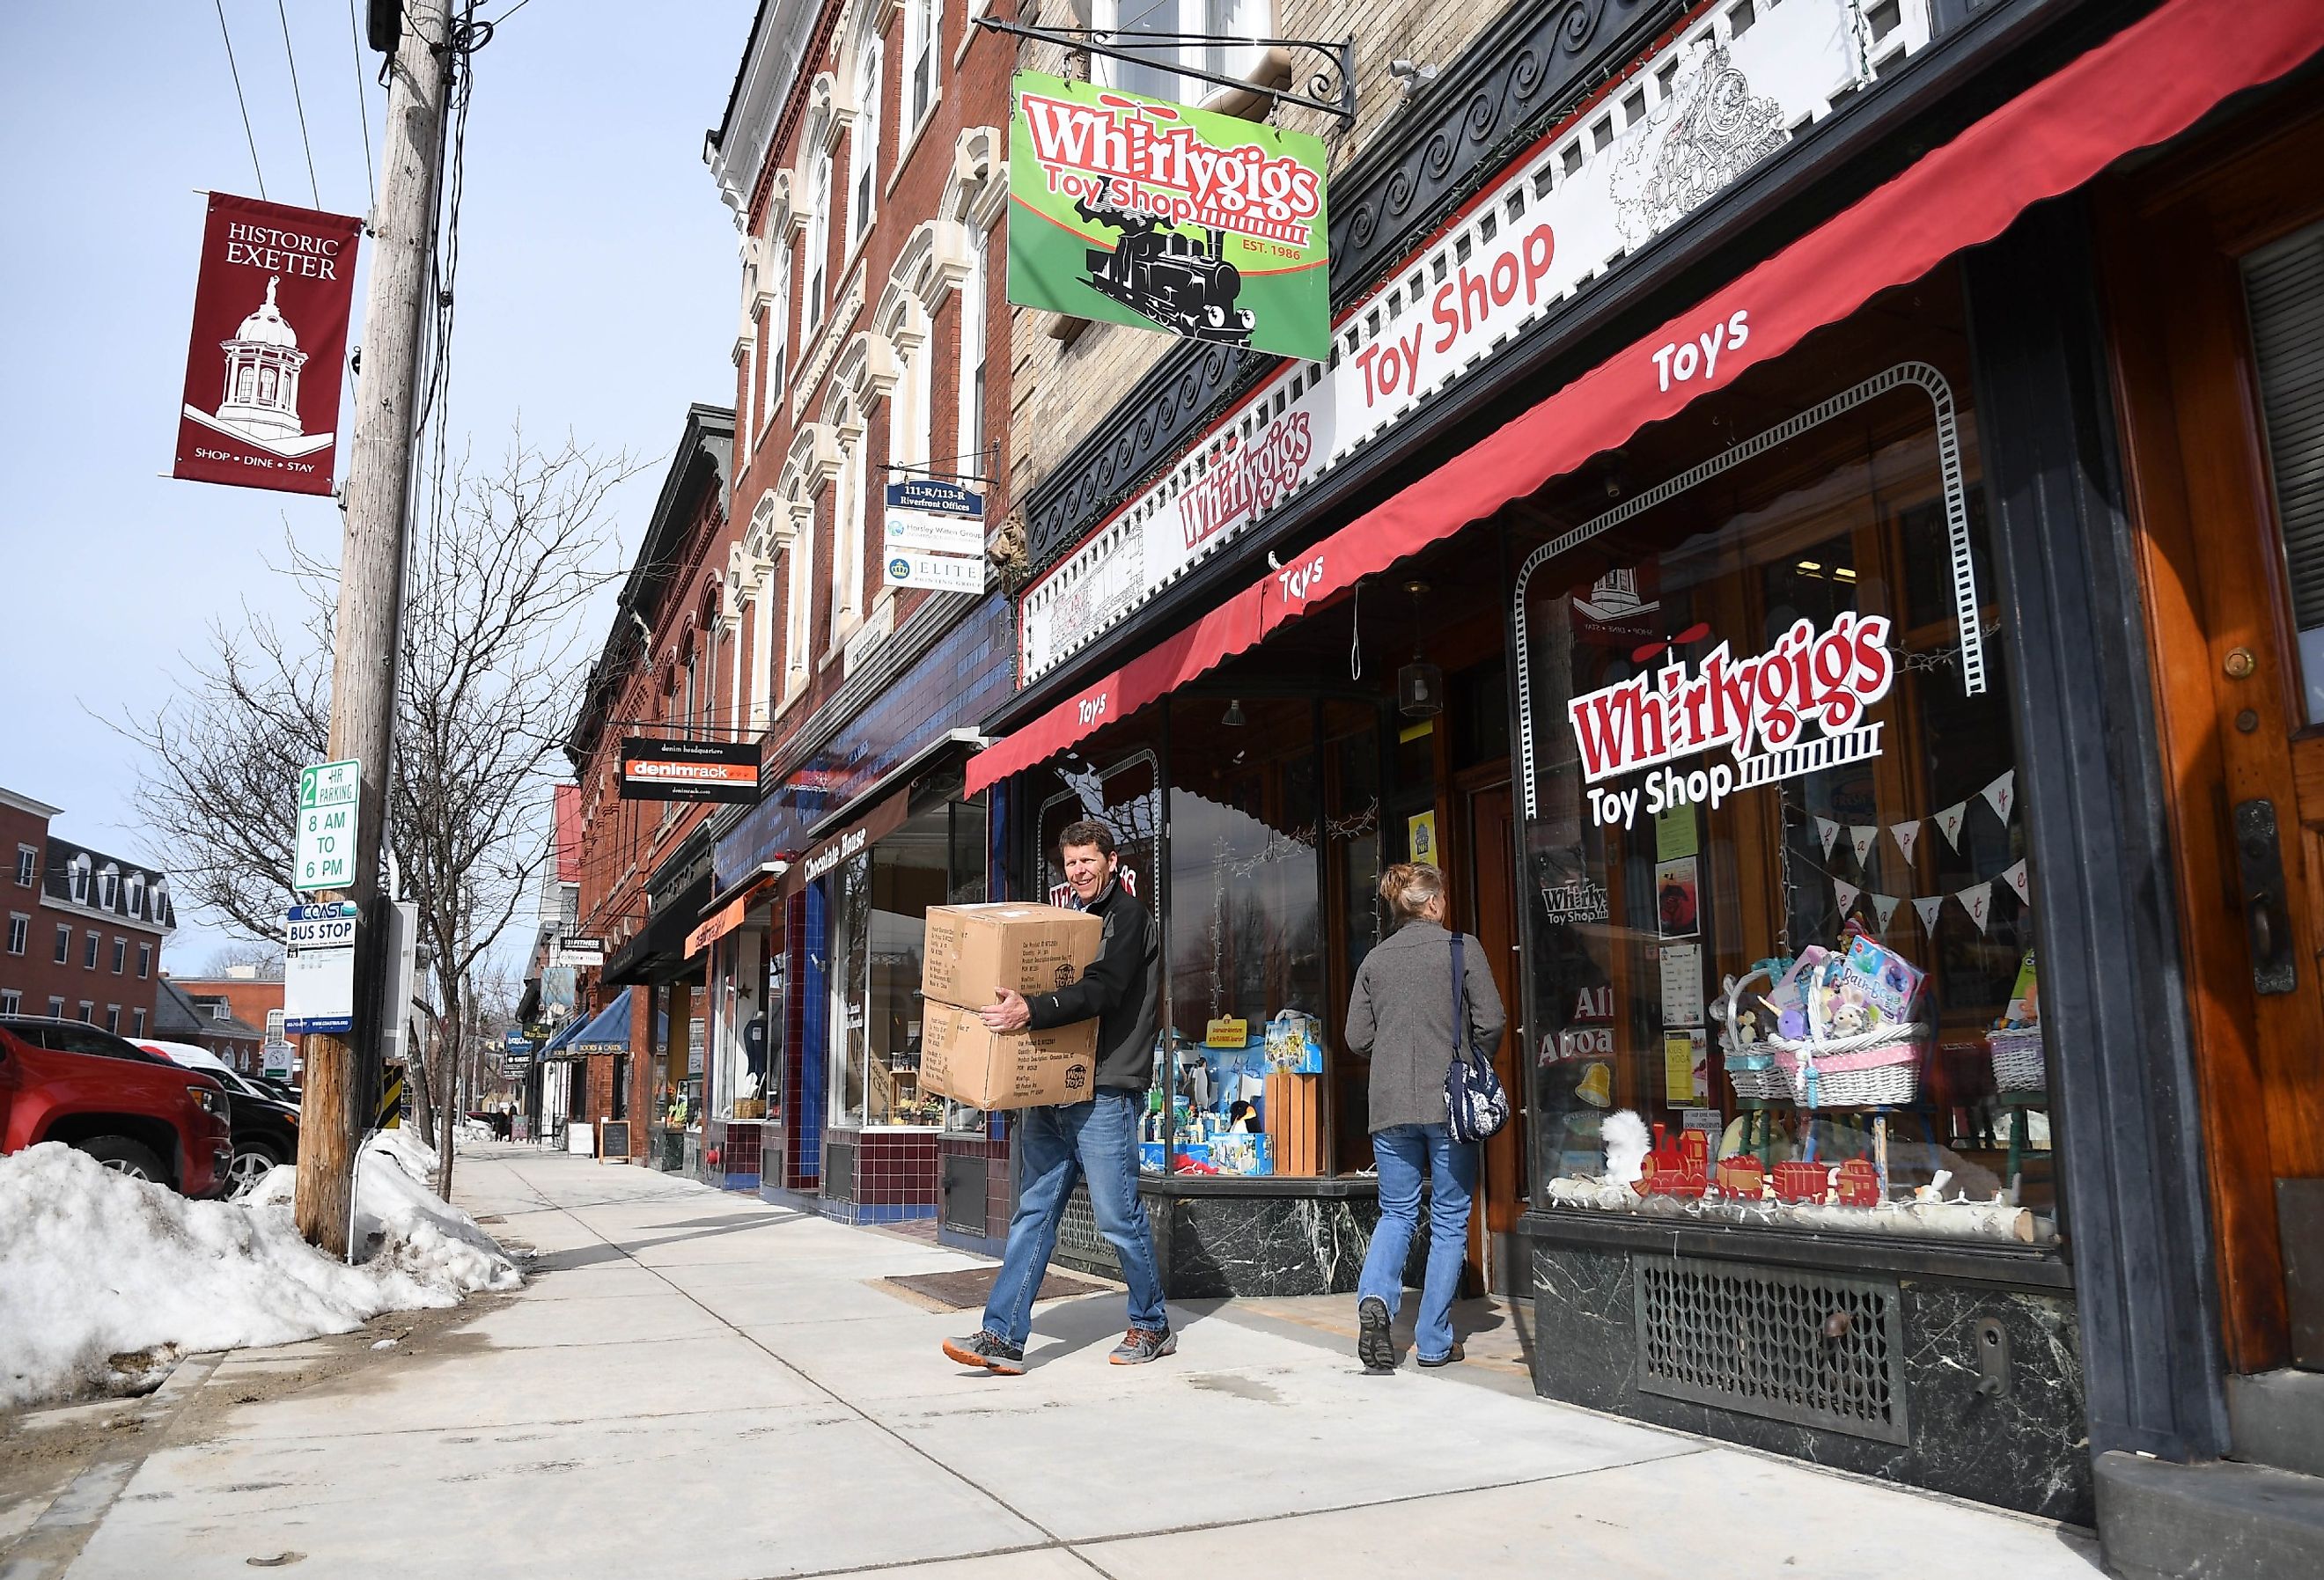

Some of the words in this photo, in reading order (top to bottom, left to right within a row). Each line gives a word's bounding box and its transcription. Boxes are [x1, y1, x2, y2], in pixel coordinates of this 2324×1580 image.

[1025, 97, 1318, 224] Whirlygigs
[1043, 165, 1100, 207] Toy
[1112, 180, 1192, 224] Shop
[228, 223, 339, 257] HISTORIC
[1242, 239, 1268, 254] EST.
[1271, 246, 1301, 261] 1986
[225, 243, 337, 280] EXETER
[1356, 322, 1423, 408] Toy
[1435, 223, 1555, 354] Shop
[195, 447, 231, 461] SHOP
[244, 456, 274, 469] DINE
[287, 461, 315, 474] STAY
[1179, 411, 1312, 549] Whirlygigs
[901, 496, 941, 508] Riverfront
[942, 502, 970, 511] Offices
[904, 486, 966, 501] 111-R/113-R
[960, 529, 982, 539] Group
[920, 562, 976, 578] ELITE
[1571, 616, 1888, 777] Whirlygigs
[661, 744, 681, 753] denim
[683, 745, 723, 754] headquarters
[329, 768, 342, 783] HR
[634, 762, 727, 778] denimrack
[302, 773, 316, 805] 2
[320, 784, 352, 802] PARKING
[1586, 787, 1637, 830] Toy
[1645, 763, 1734, 810] Shop
[308, 815, 317, 832] 8
[324, 812, 345, 830] AM
[317, 836, 335, 854] TO
[805, 843, 839, 882] Chocolate
[841, 827, 866, 859] House
[305, 861, 314, 878] 6
[322, 858, 342, 877] PM
[1542, 884, 1607, 913] Whirly
[303, 902, 343, 920] COAST
[1548, 914, 1565, 926] Toy
[1568, 911, 1595, 922] Shop
[290, 925, 314, 940] BUS
[319, 922, 351, 938] STOP
[1574, 987, 1614, 1018] All
[1537, 1028, 1614, 1068] Aboa
